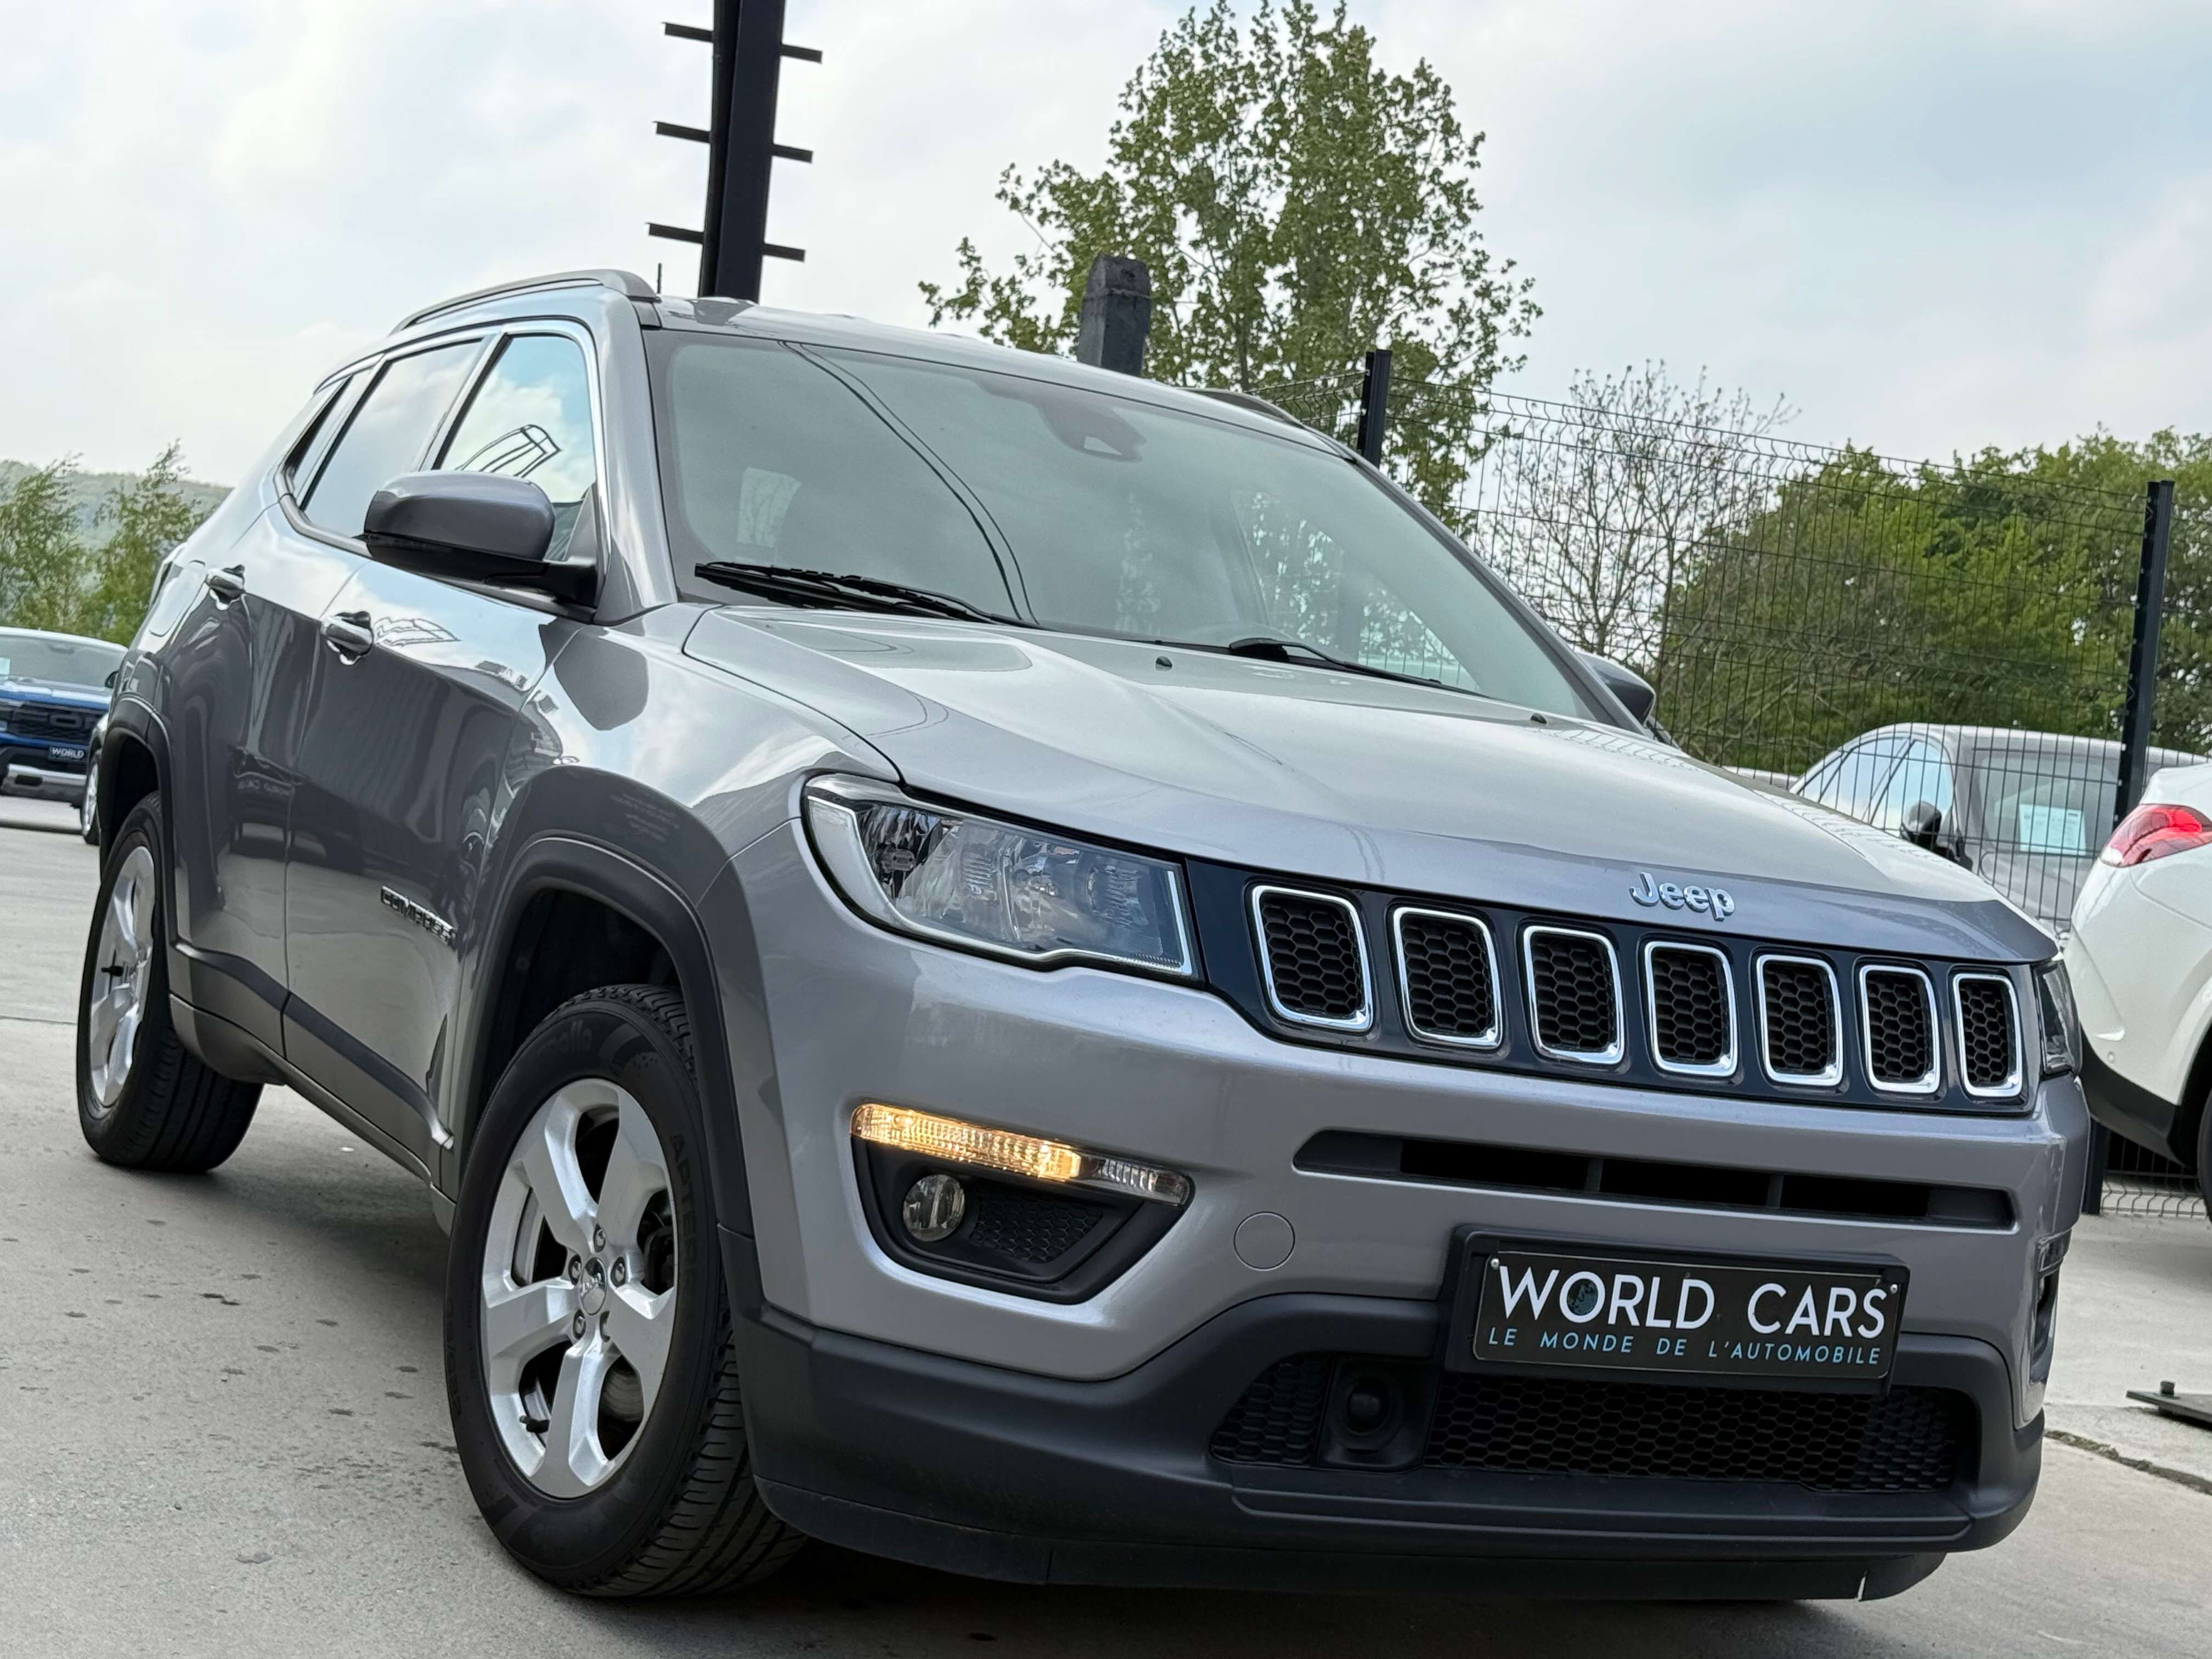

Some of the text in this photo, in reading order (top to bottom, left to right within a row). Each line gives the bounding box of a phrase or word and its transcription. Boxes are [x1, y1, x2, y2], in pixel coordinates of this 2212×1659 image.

[52, 747, 85, 759] WORLD
[1629, 871, 1735, 922] Jeep
[1499, 1265, 1887, 1339] WORLD CARS
[1488, 1327, 1881, 1365] LE MONDE DE L'AUTOMOBILE
